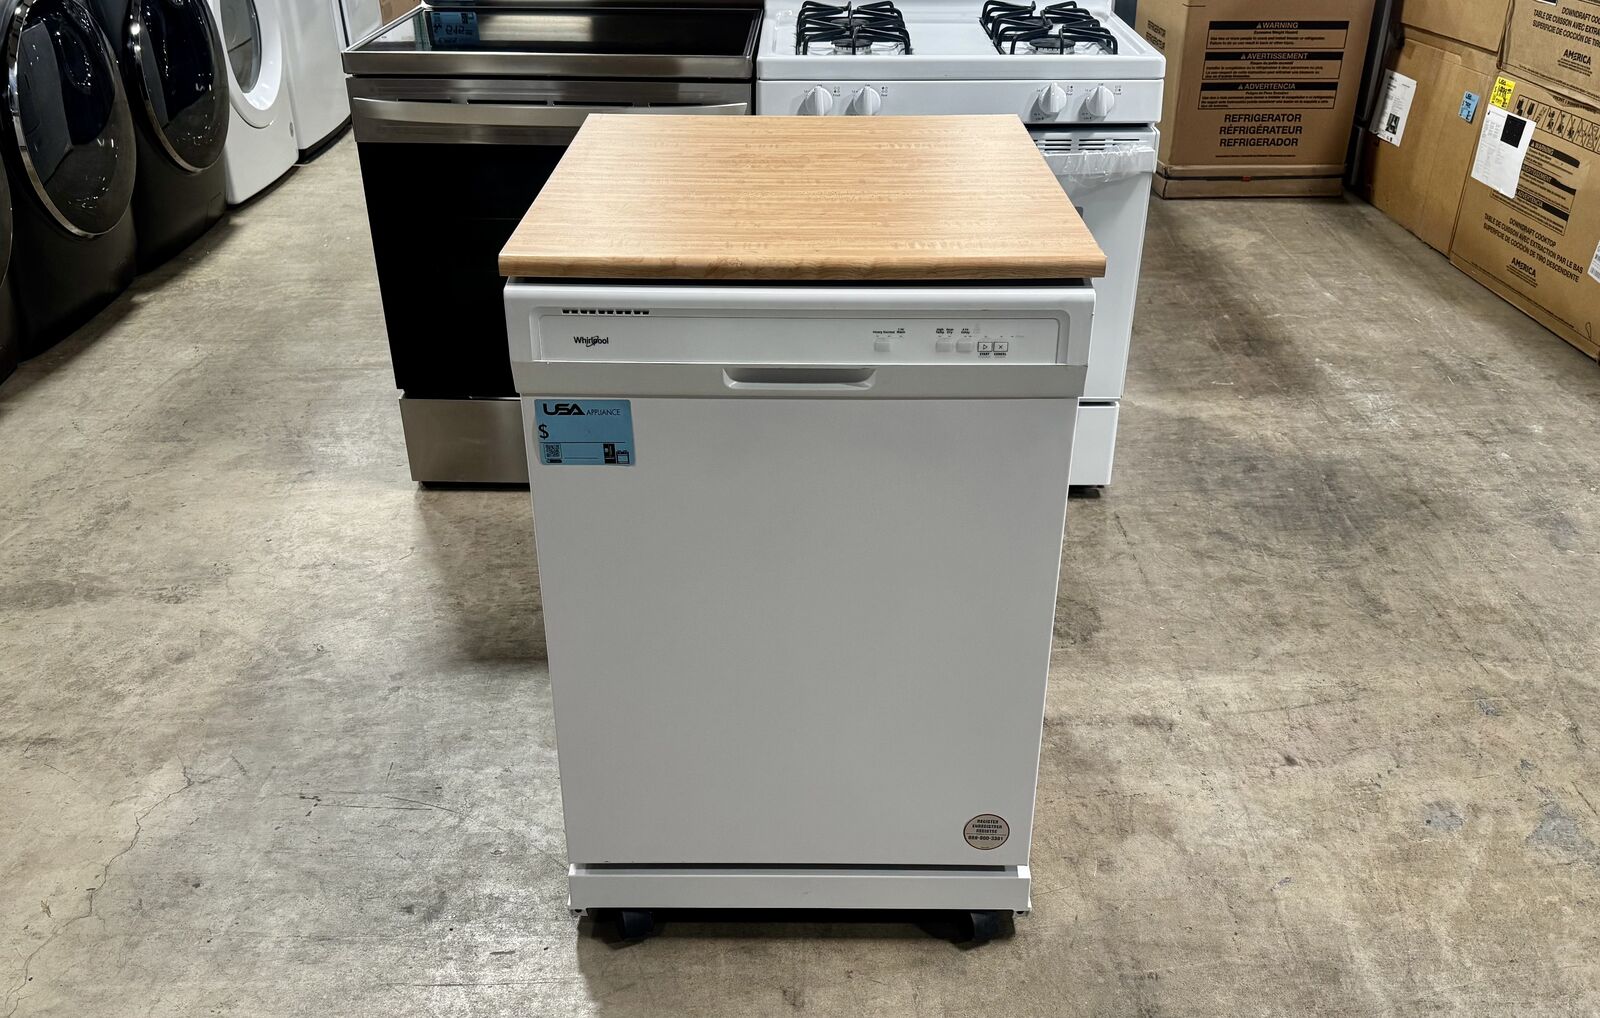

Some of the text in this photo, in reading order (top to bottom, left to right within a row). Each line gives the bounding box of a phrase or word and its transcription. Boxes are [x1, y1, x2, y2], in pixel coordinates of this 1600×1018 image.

[1534, 9, 1546, 19] TABLE
[1552, 15, 1572, 27] CUISSON
[1572, 21, 1585, 31] AVEC
[1562, 6, 1591, 22] DOWNDRAFT
[1532, 20, 1556, 33] SUPERFICIE
[1556, 27, 1563, 35] DE
[1563, 30, 1584, 42] COCCIÓN
[1585, 36, 1592, 44] DE
[1563, 49, 1592, 65] AMERICA
[1224, 113, 1302, 122] REFRIGERATOR
[1219, 124, 1303, 135] RÉFRIGÉRATEUR
[1220, 138, 1299, 147] REFRIGERADOR
[1509, 218, 1535, 238] DOWNDRAFT
[1535, 231, 1556, 248] COOKTOP
[1484, 223, 1504, 240] SUPERFICIE
[1504, 234, 1511, 243] DE
[1511, 237, 1529, 255] COCCIÓN
[1529, 249, 1536, 258] DE
[1536, 253, 1546, 264] TIRO
[1546, 259, 1580, 282] DESCENDENTE
[1495, 219, 1501, 228] DE
[1500, 221, 1519, 238] CUISSON
[1519, 233, 1529, 244] AVEC
[1530, 239, 1556, 259] EXTRACTION
[1556, 254, 1566, 264] PAR
[1566, 260, 1573, 269] LE
[1573, 263, 1583, 274] BAS
[1511, 257, 1536, 278] AMERICA
[574, 335, 609, 348] Whirlpool
[543, 403, 585, 416] USA
[538, 423, 549, 440] $
